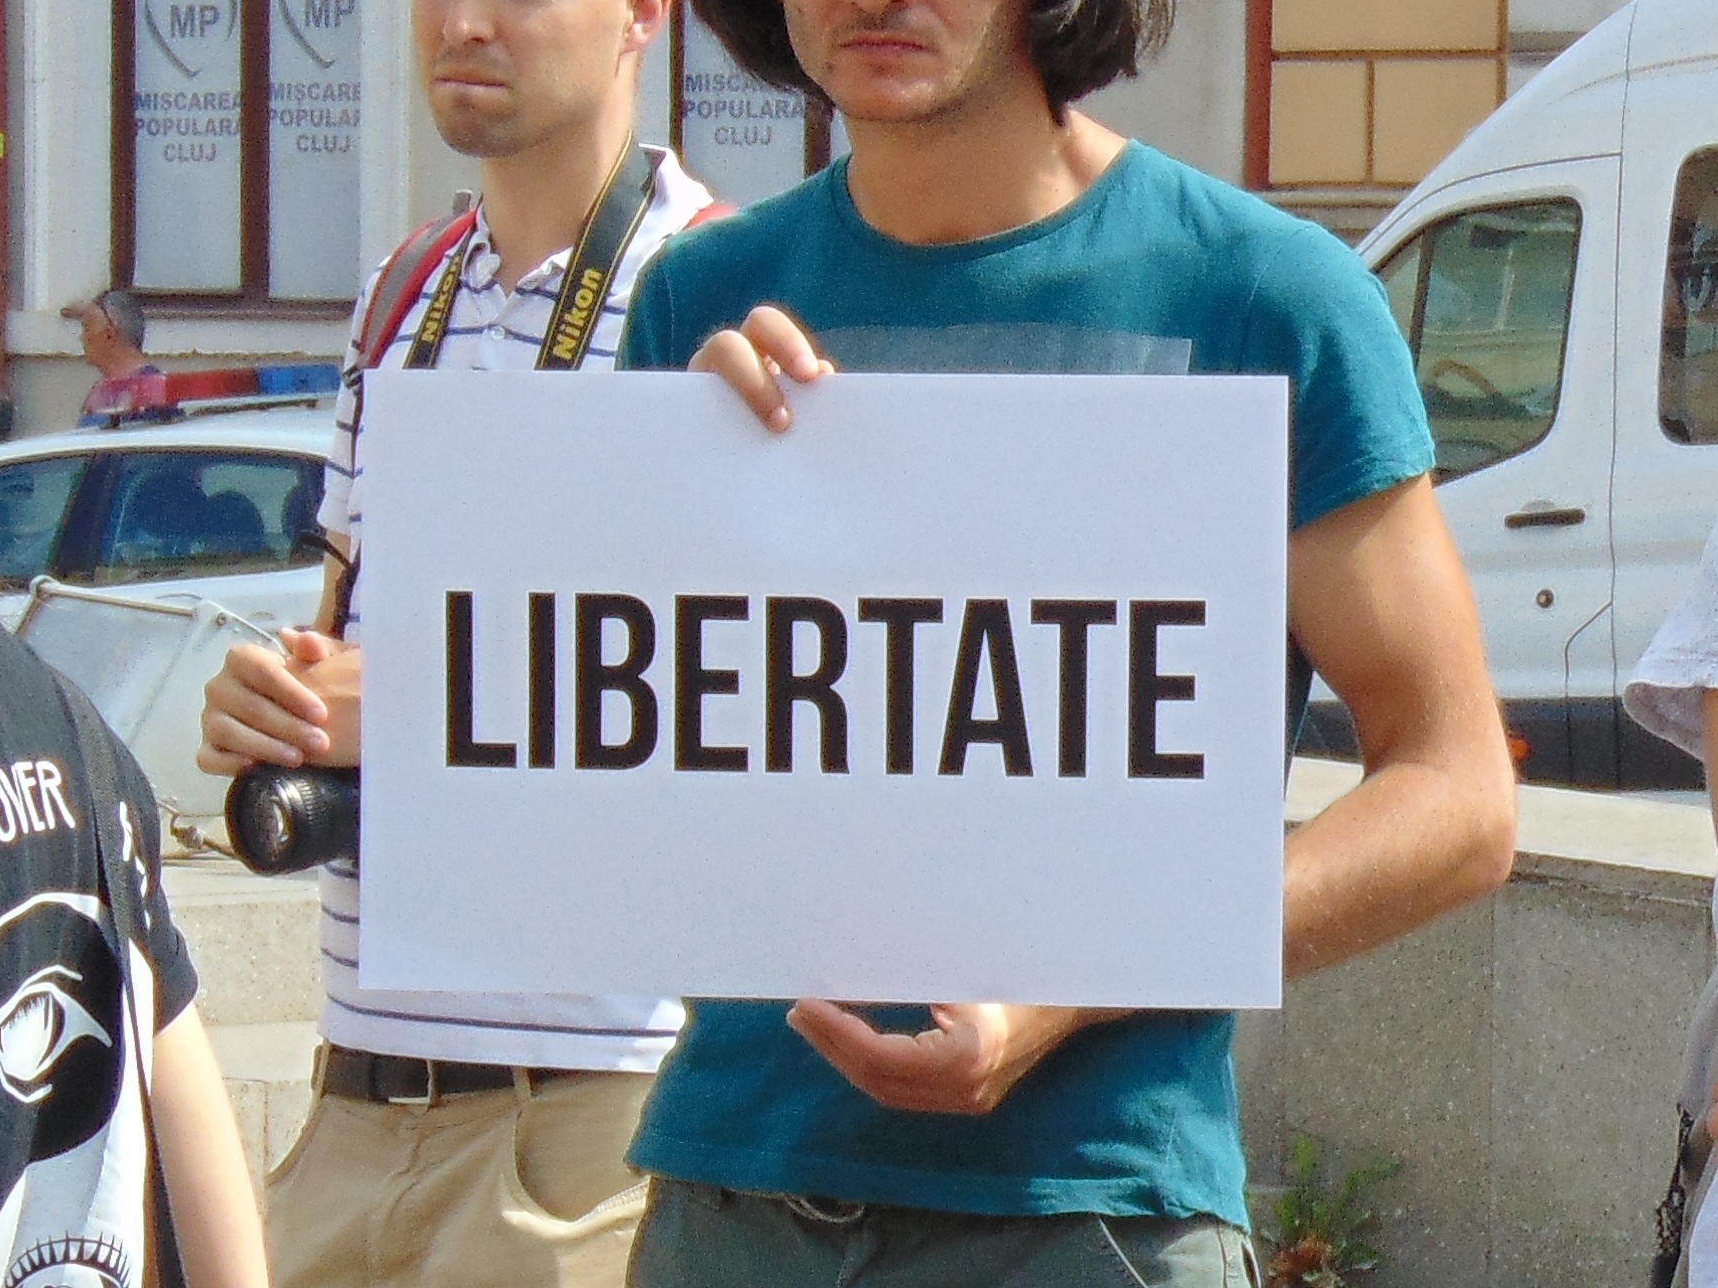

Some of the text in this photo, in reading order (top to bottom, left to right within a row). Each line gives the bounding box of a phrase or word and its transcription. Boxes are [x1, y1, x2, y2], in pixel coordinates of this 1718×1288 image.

[169, 4, 220, 39] MP
[296, 134, 350, 153] CLUJ
[714, 126, 773, 146] CLUJ
[164, 143, 217, 162] CLUJ
[552, 269, 602, 360] Nikon
[444, 590, 1207, 779] LIBERTATE
